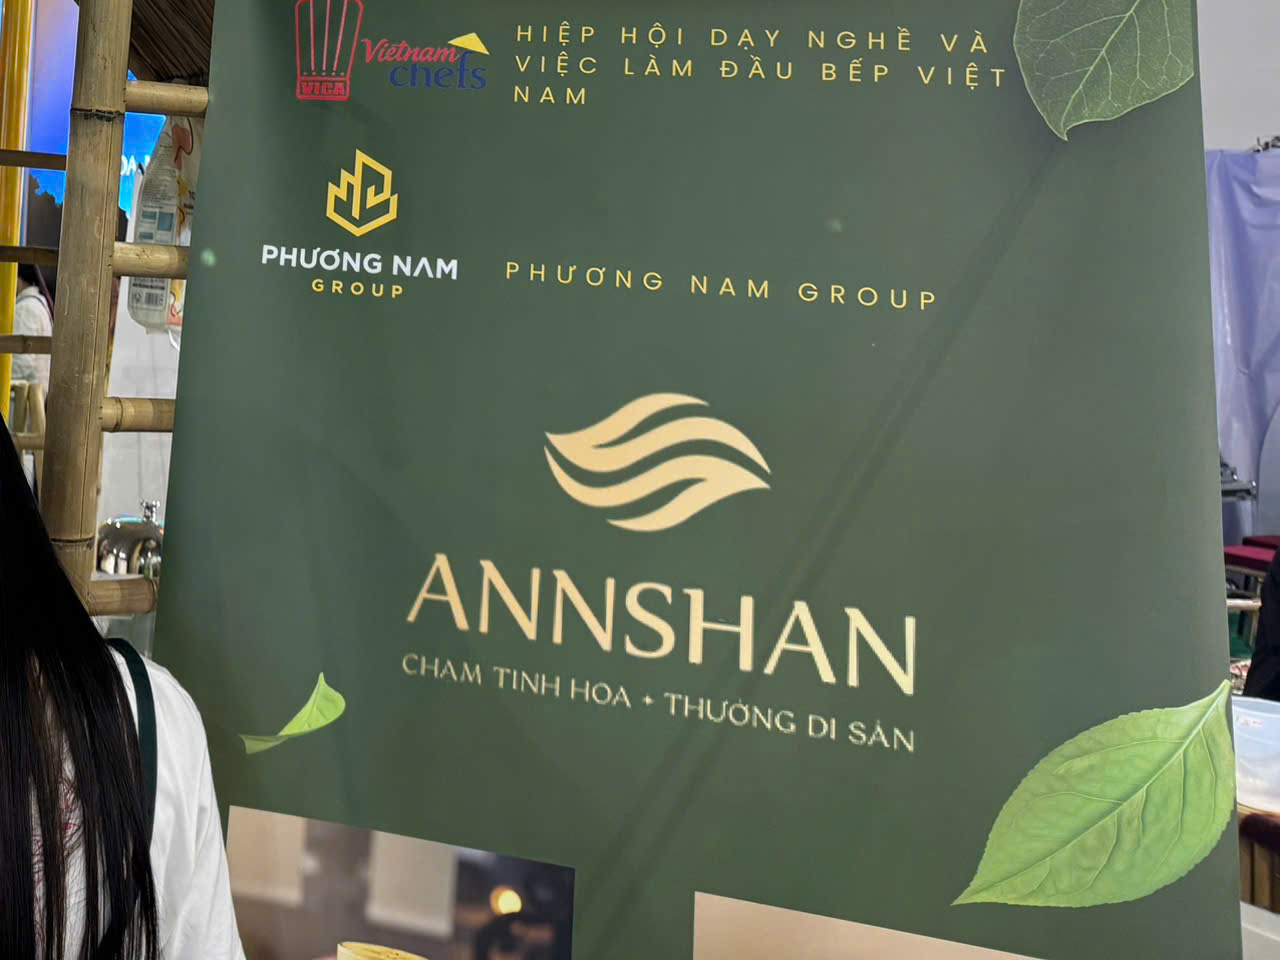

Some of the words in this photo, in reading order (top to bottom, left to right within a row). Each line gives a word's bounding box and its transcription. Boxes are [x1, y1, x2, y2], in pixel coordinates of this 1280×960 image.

[517, 20, 595, 47] HIỆP
[621, 22, 682, 49] HỘI
[711, 28, 780, 51] DẠY
[808, 26, 911, 51] NGHỀ
[940, 29, 988, 54] VÀ
[300, 82, 345, 96] VICA
[361, 38, 460, 64] Vietnam
[389, 50, 488, 90] chefs
[515, 50, 597, 77] VIỆC
[624, 54, 692, 77] LÀM
[719, 54, 793, 79] ĐẦU
[821, 58, 889, 82] BẾP
[917, 62, 1006, 90] VIỆT
[513, 86, 586, 105] NAM
[261, 244, 382, 274] PHƯƠNG
[392, 255, 458, 280] NAM
[311, 279, 403, 298] GROUP
[506, 261, 663, 291] PHƯƠNG
[690, 275, 769, 299] NAM
[798, 282, 936, 310] GROUP
[406, 552, 916, 697] ANNSHAN
[571, 678, 632, 708] HOA
[808, 714, 836, 740] DI
